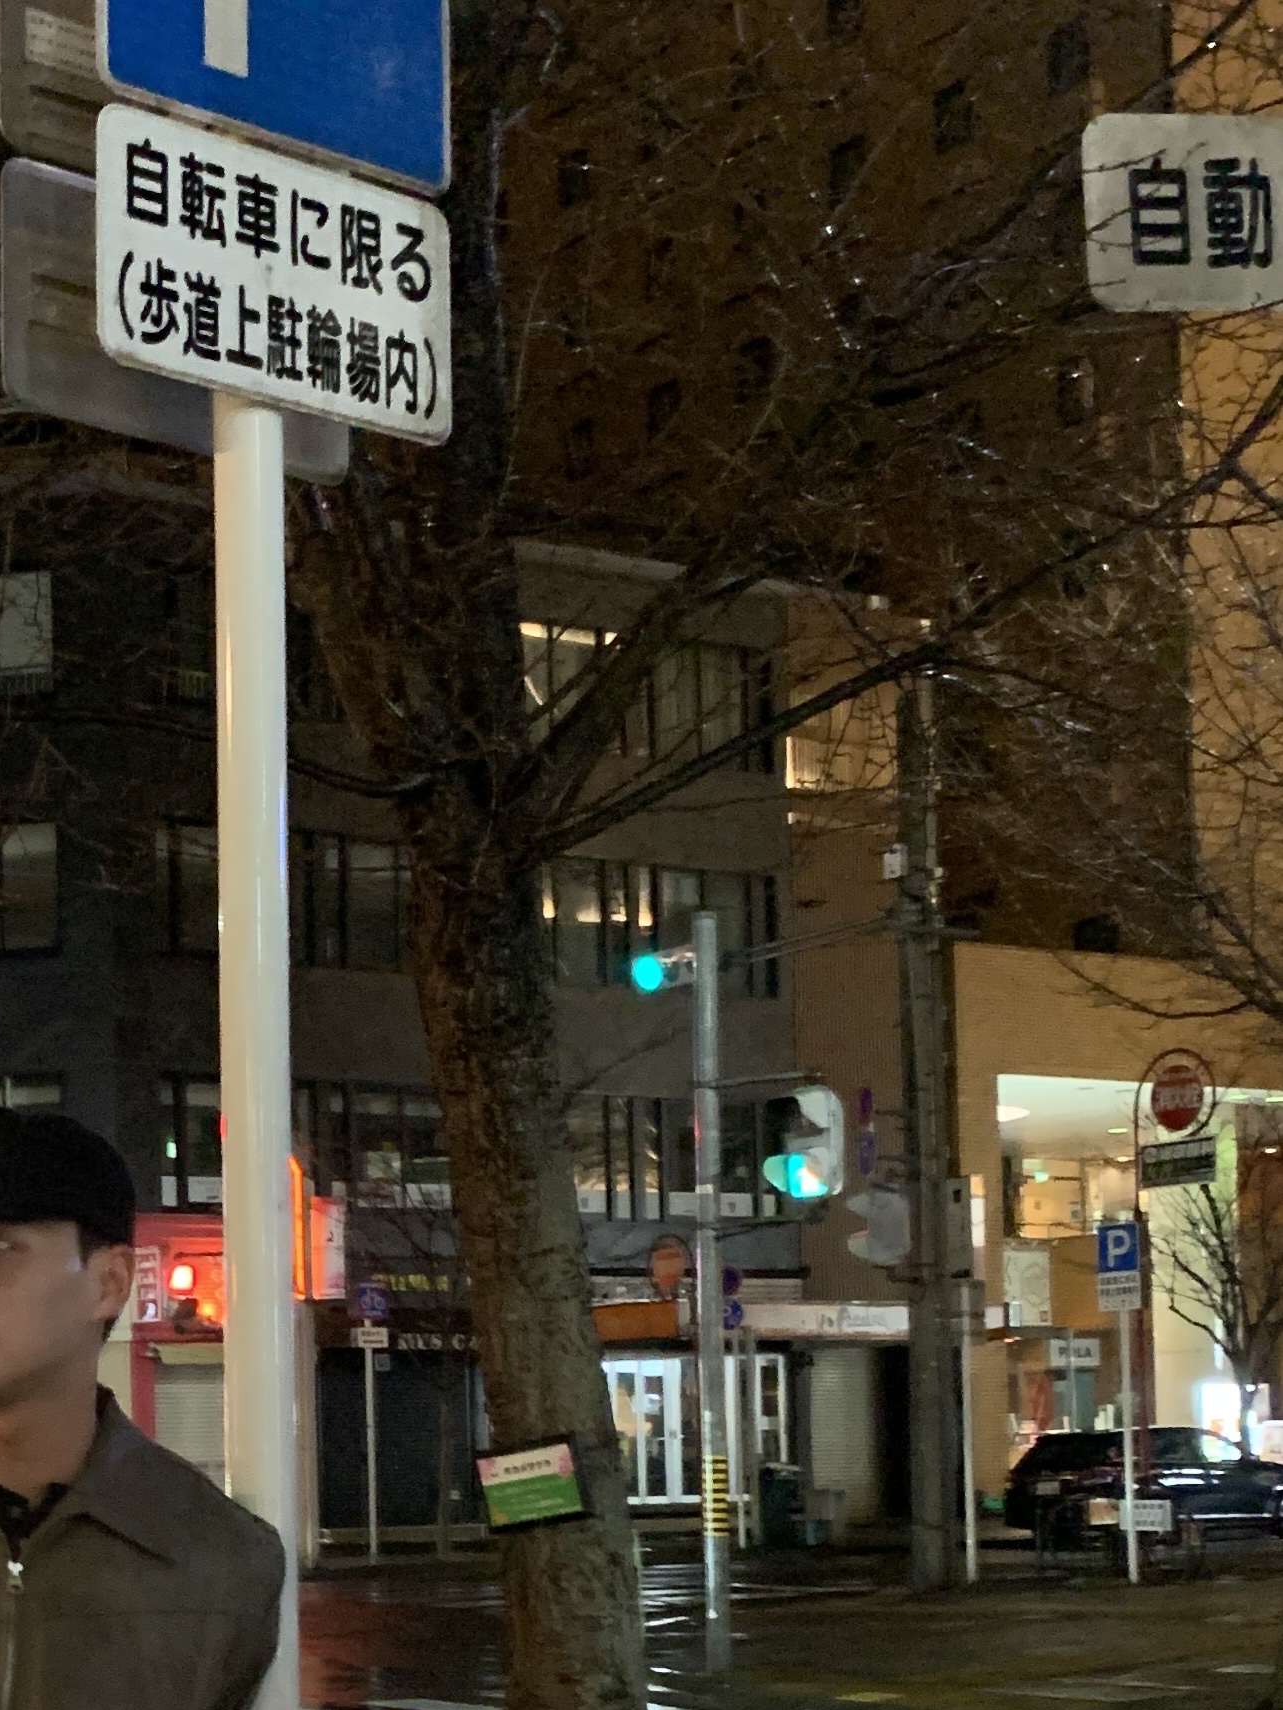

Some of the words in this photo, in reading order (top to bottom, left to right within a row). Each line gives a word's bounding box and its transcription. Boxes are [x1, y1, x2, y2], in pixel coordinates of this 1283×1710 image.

[125, 138, 432, 302] 自転車に限る
[1129, 157, 1273, 269] 自動
[118, 250, 437, 419] (歩道上駐輪場内)
[1107, 1228, 1130, 1268] P
